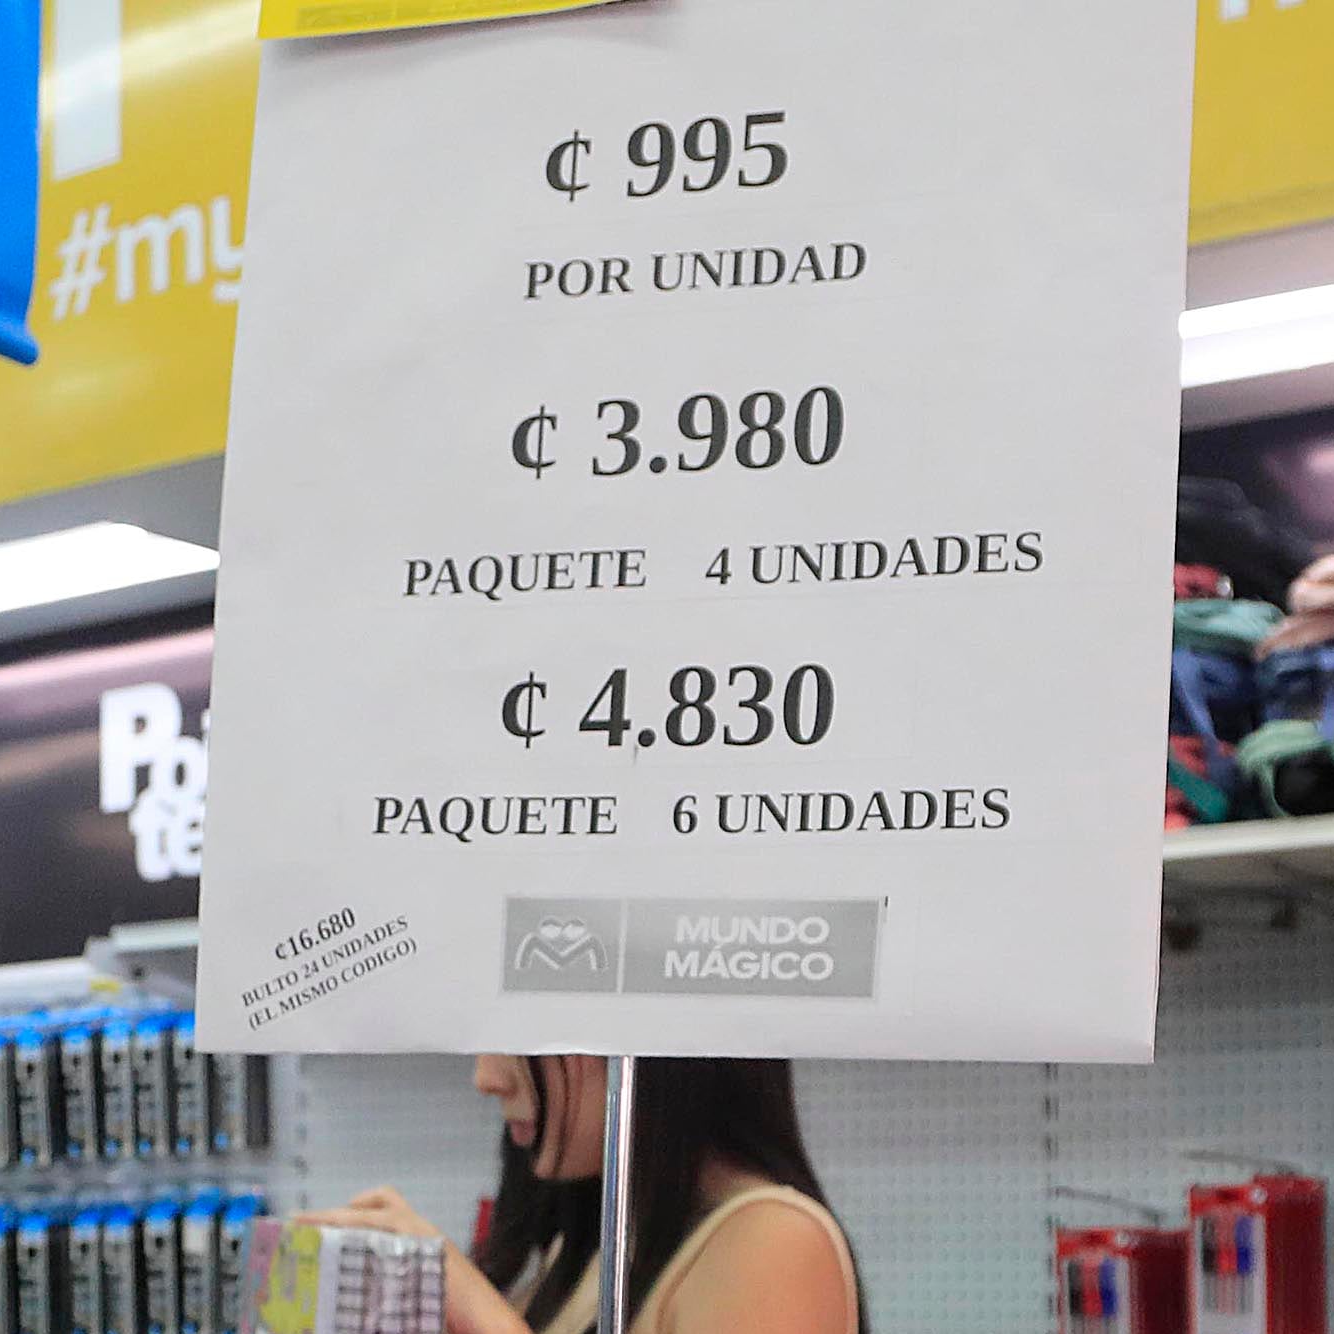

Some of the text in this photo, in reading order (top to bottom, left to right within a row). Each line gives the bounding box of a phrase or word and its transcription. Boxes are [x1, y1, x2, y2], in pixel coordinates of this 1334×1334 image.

[626, 111, 788, 198] 995
[525, 242, 866, 300] POR UNIDAD
[592, 386, 844, 477] 3.980
[403, 531, 1043, 602] PAQUETE 4 UNIDADES
[578, 664, 834, 748] 4.830
[372, 787, 1010, 843] PAQUETE 6 UNIDADES
[242, 915, 408, 1007] BULTO 24 UNIDADES
[665, 944, 835, 980] MÁGICO
[677, 915, 830, 945] MUNDO
[249, 938, 417, 1031] (EL MISMO CODIGO)
